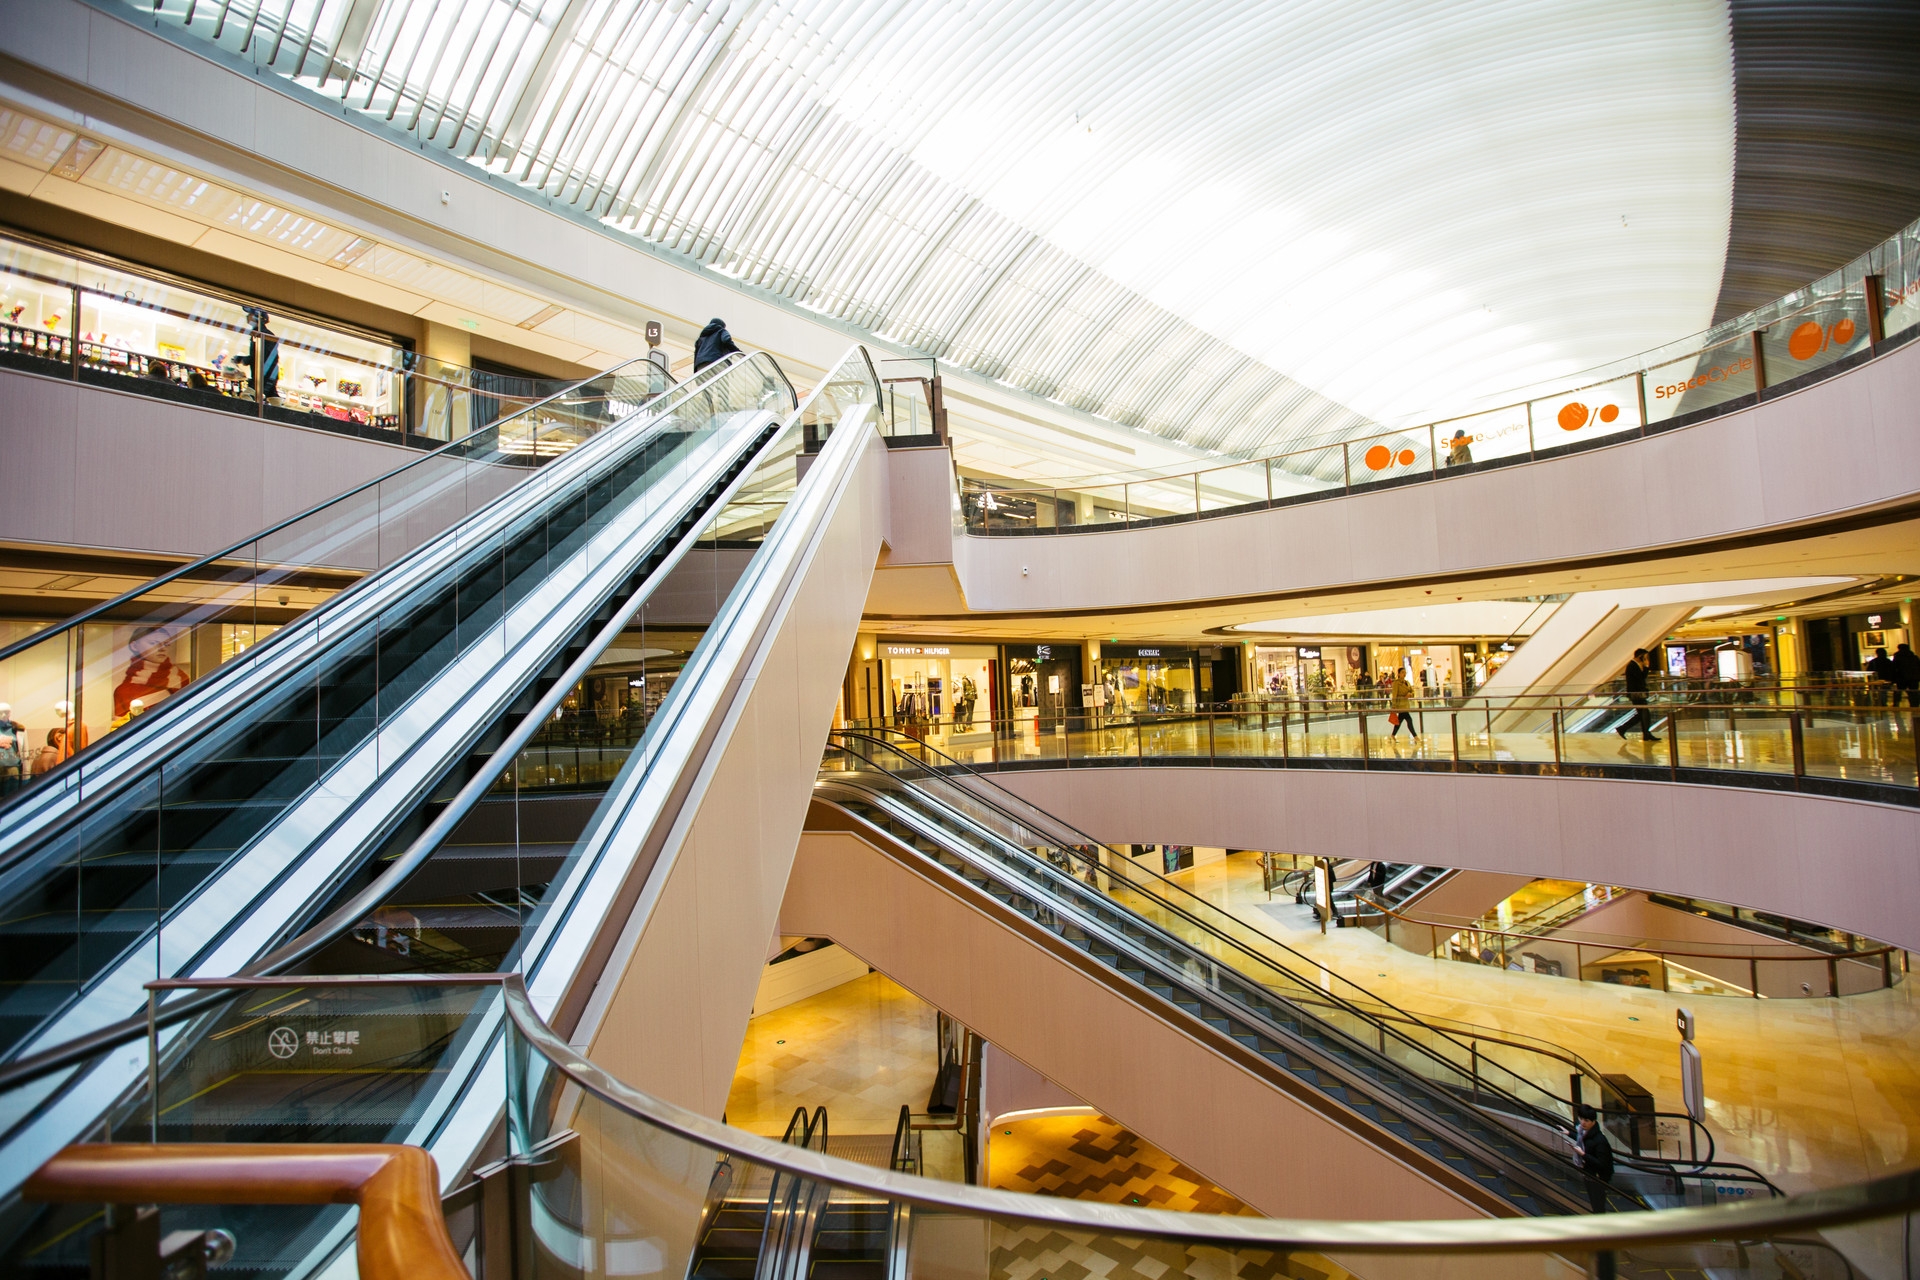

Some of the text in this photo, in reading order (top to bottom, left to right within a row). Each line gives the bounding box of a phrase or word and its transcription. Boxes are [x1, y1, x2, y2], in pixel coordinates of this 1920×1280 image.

[648, 328, 658, 337] L3
[1655, 357, 1753, 399] SpaceCycle
[888, 647, 915, 655] TOMMY
[306, 1031, 360, 1045] 禁止攀爬
[313, 1047, 353, 1055] Don't Climb
